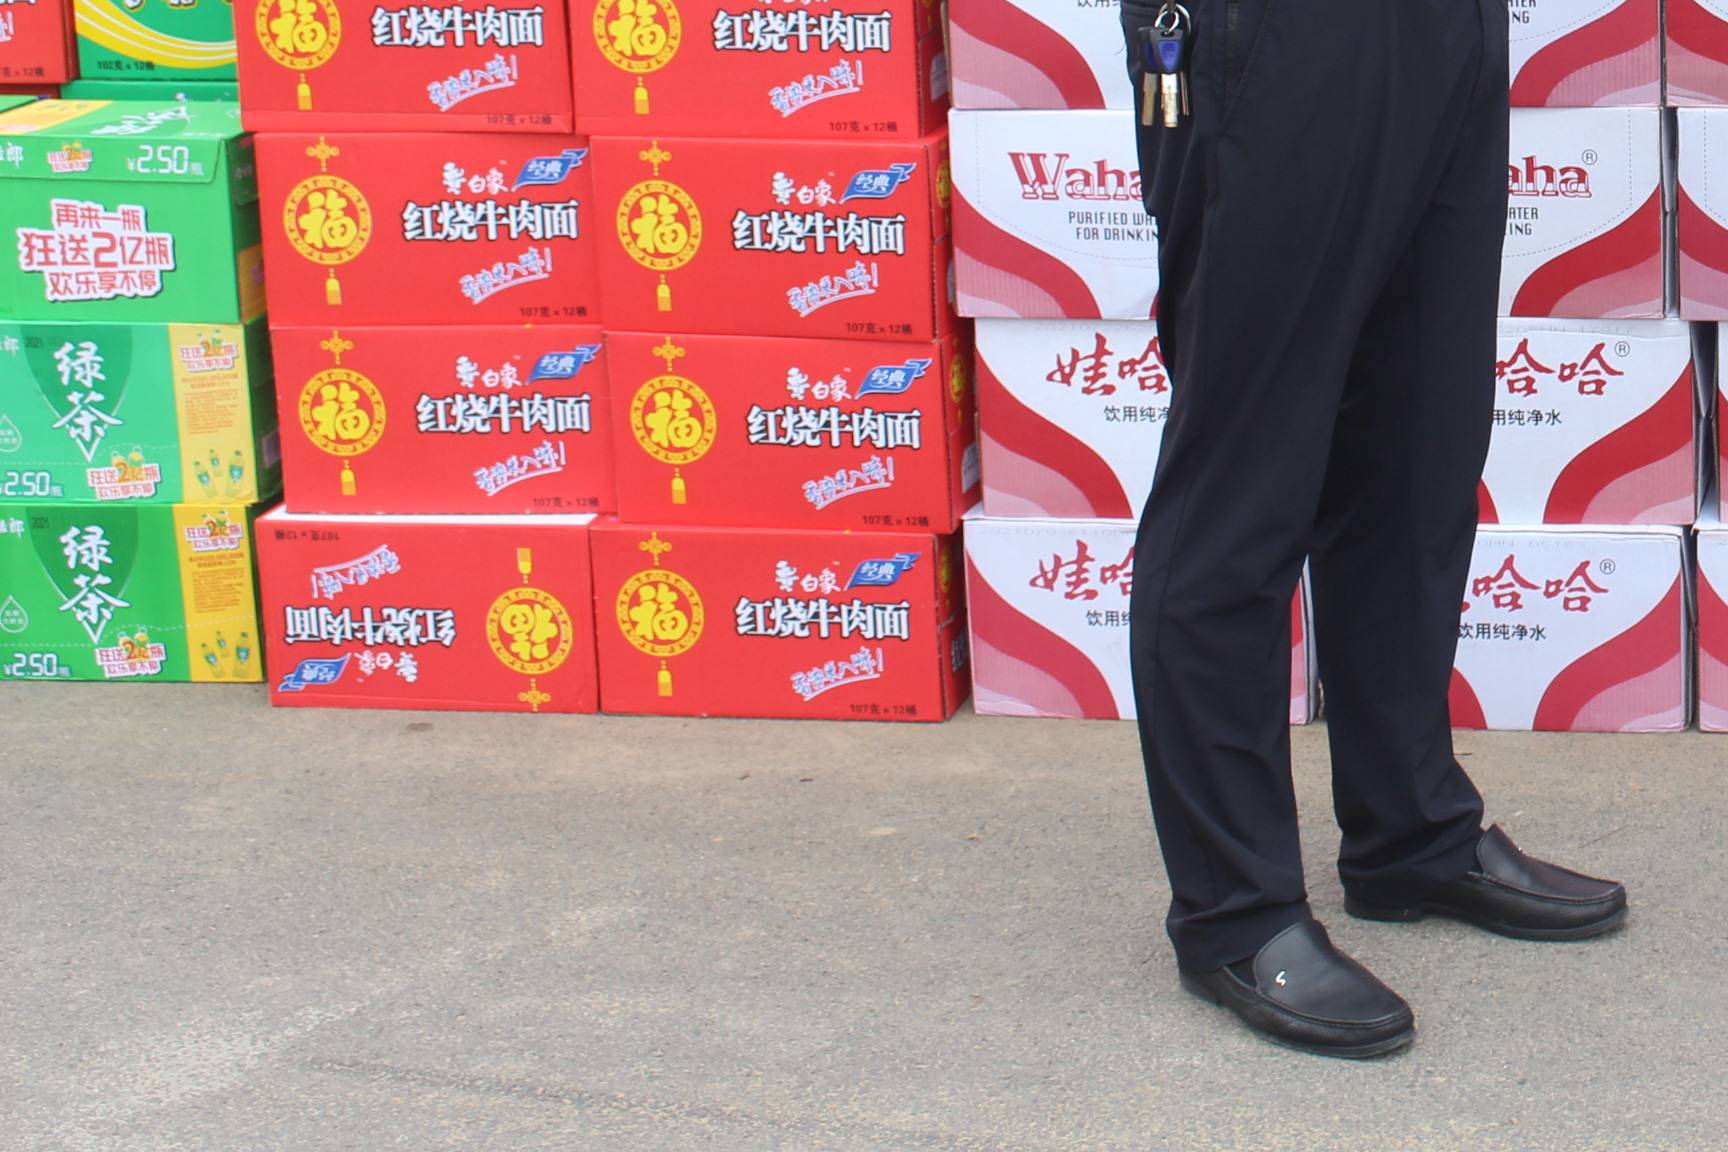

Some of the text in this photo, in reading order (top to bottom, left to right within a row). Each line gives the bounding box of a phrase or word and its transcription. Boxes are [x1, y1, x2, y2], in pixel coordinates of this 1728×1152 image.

[372, 8, 543, 46] 红烧牛肉面
[713, 10, 890, 50] 红烧牛肉面
[56, 205, 141, 229] 再来一瓶
[299, 192, 358, 249] 福
[404, 200, 578, 239] 红烧牛肉面
[732, 211, 905, 253] 红烧牛肉面
[1069, 212, 1128, 226] PURIFIED
[1077, 228, 1097, 240] FOR
[22, 231, 168, 268] 狂送2亿瓶
[48, 271, 156, 297] 欢乐享不停
[542, 355, 574, 374] 经典
[871, 367, 905, 387] 经典
[54, 342, 122, 441] 绿茶
[417, 393, 591, 432] 红烧牛肉面
[747, 407, 920, 448] 红烧牛肉面
[60, 525, 128, 622] 绿茶
[285, 607, 455, 645] 红烧牛肉面
[735, 597, 909, 639] 红烧牛肉面
